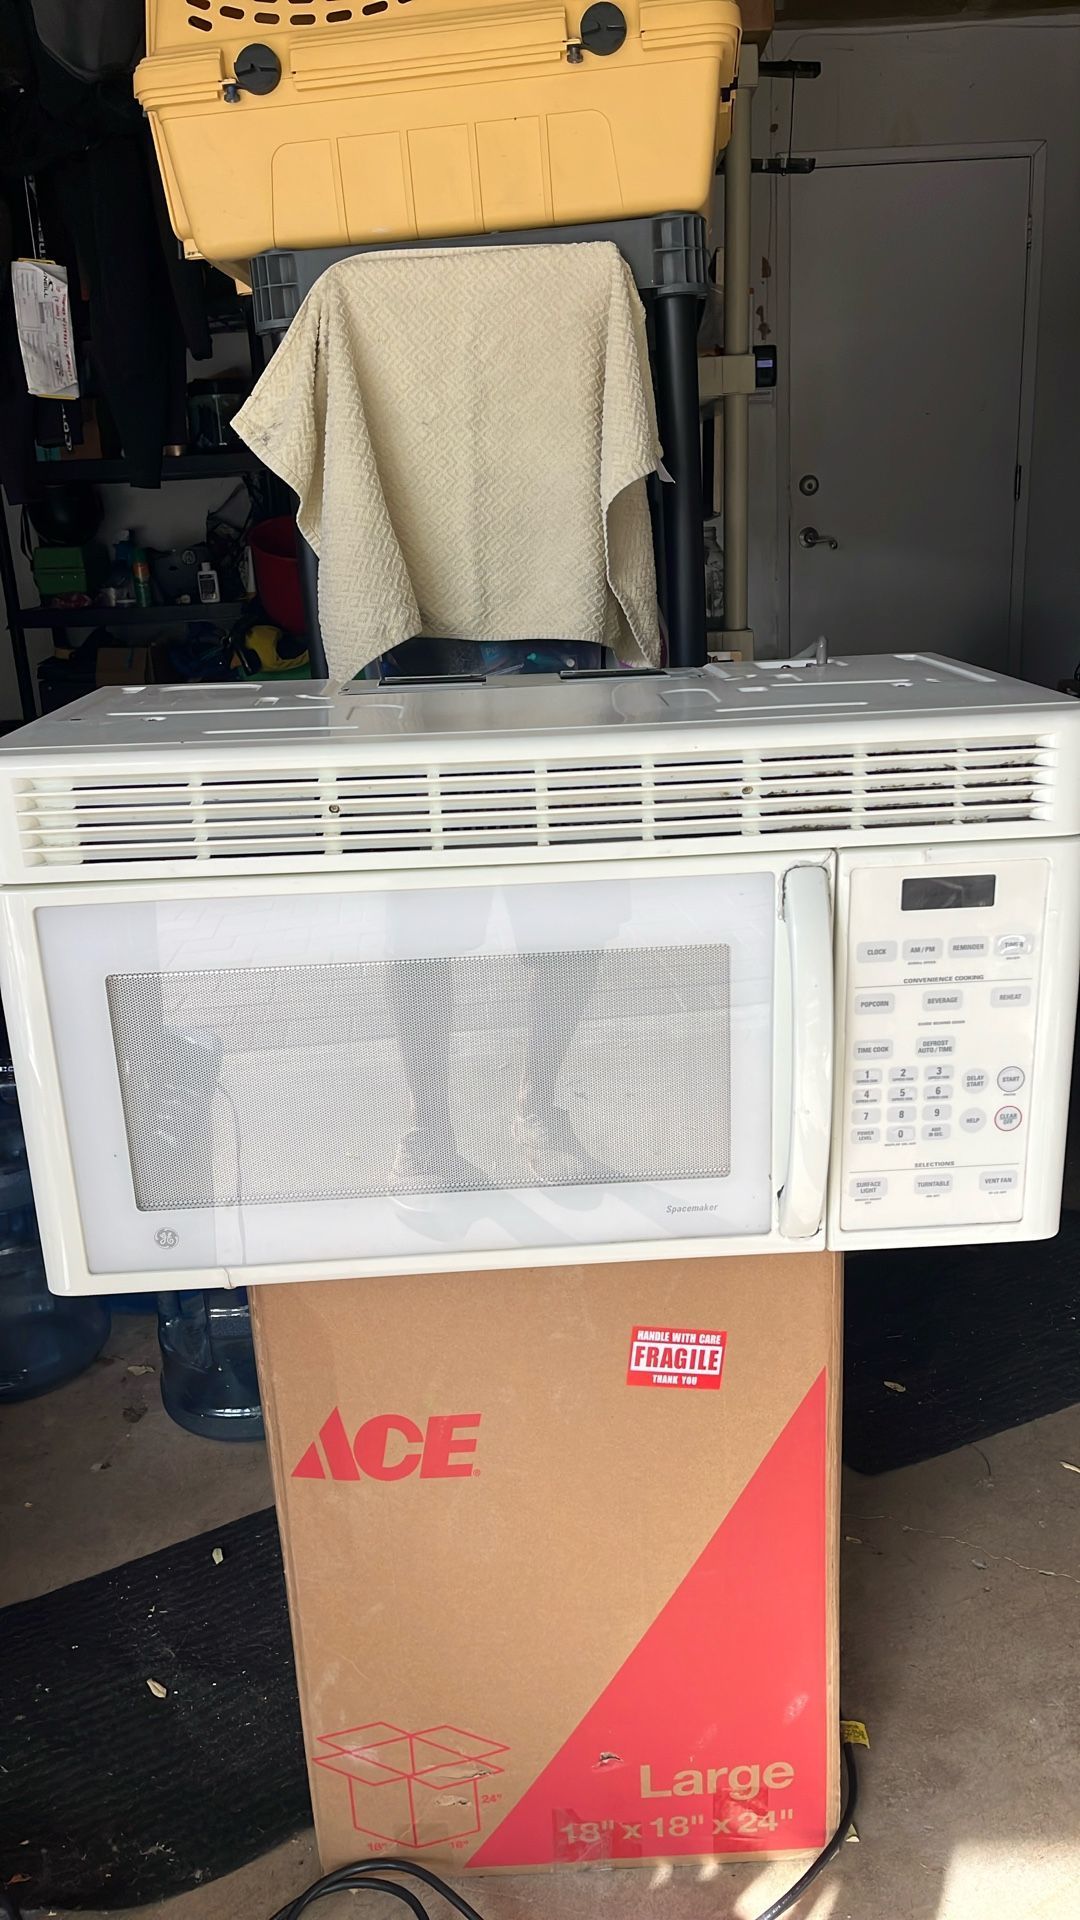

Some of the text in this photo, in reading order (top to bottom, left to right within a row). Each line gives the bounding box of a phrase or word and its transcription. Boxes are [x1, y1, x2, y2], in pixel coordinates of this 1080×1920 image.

[865, 1070, 870, 1079] 1
[900, 1068, 906, 1077] 2
[936, 1066, 942, 1075] 3
[864, 1090, 869, 1099] 4
[900, 1088, 906, 1097] 5
[935, 1086, 941, 1095] 6
[863, 1112, 869, 1120] 7
[899, 1110, 904, 1119] 8
[934, 1108, 940, 1117] 9
[898, 1129, 904, 1138] 0
[666, 1203, 718, 1214] Spacemaker
[637, 1330, 722, 1345] HANDLE WITH CARE
[634, 1345, 719, 1371] FRAGILE
[652, 1374, 698, 1386] THANK YOU
[640, 1761, 795, 1801] Large
[481, 1794, 502, 1803] 24"
[560, 1808, 794, 1845] 18" x 18" x 24"
[450, 1840, 469, 1849] 18"
